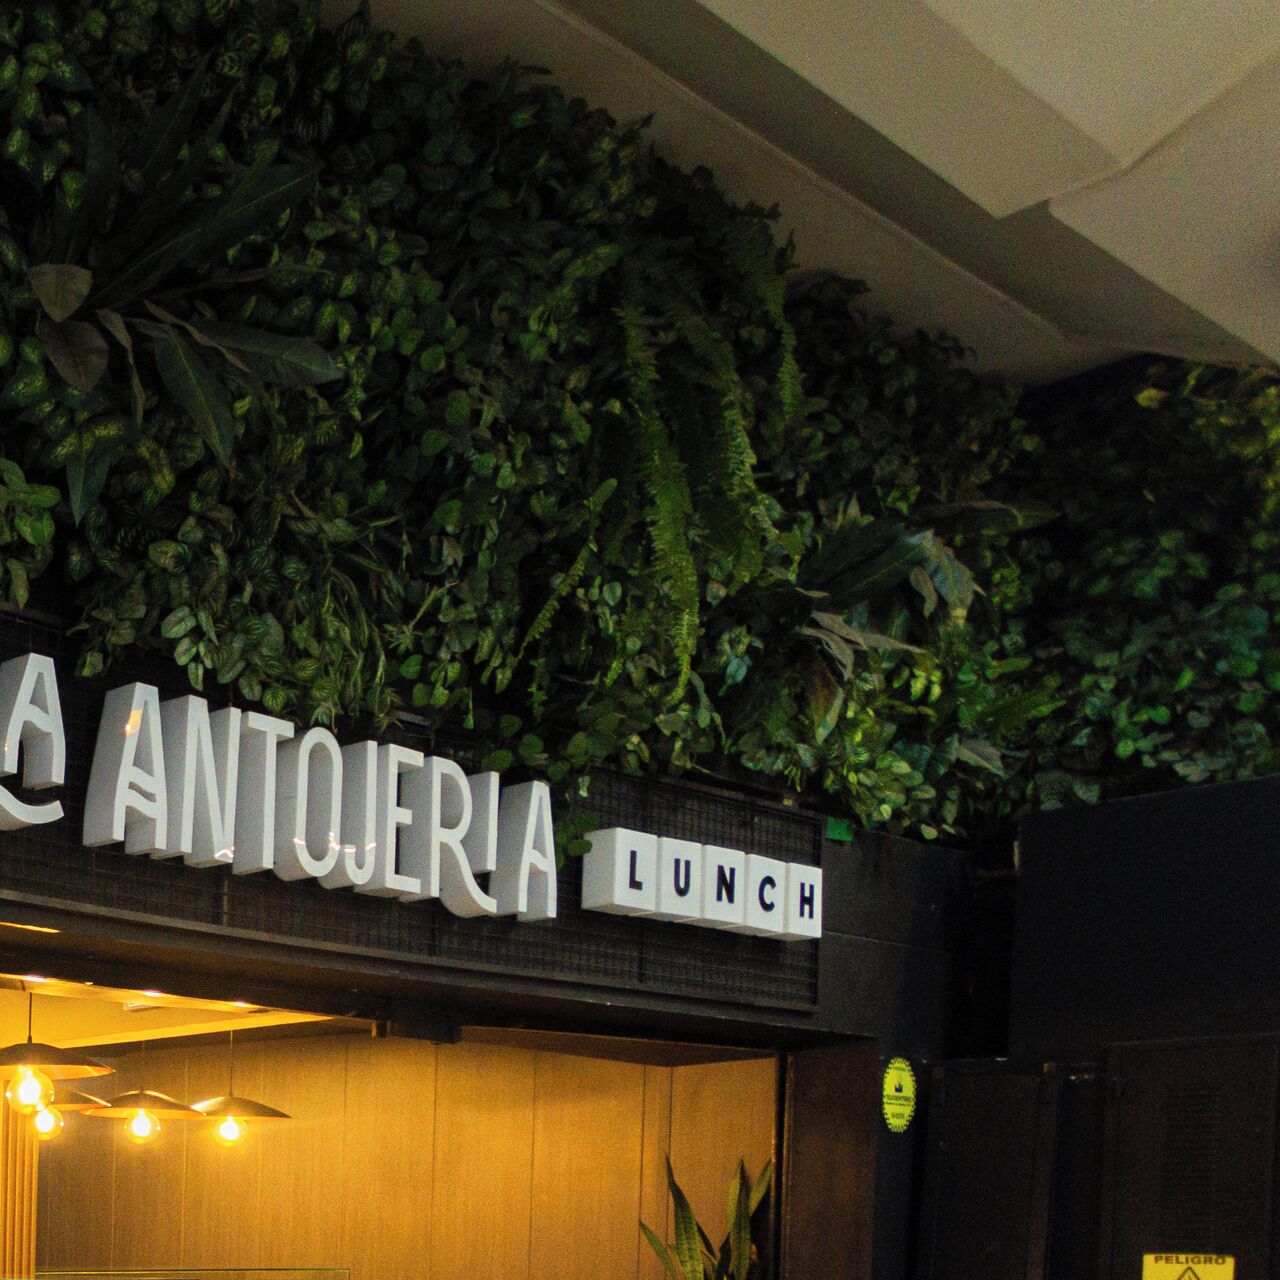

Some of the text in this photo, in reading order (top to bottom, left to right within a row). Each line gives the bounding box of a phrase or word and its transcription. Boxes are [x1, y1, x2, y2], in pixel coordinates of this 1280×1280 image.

[82, 680, 558, 921] ANTOJERIA
[627, 847, 817, 921] LUNCH
[1154, 1255, 1226, 1265] PELIGRO
